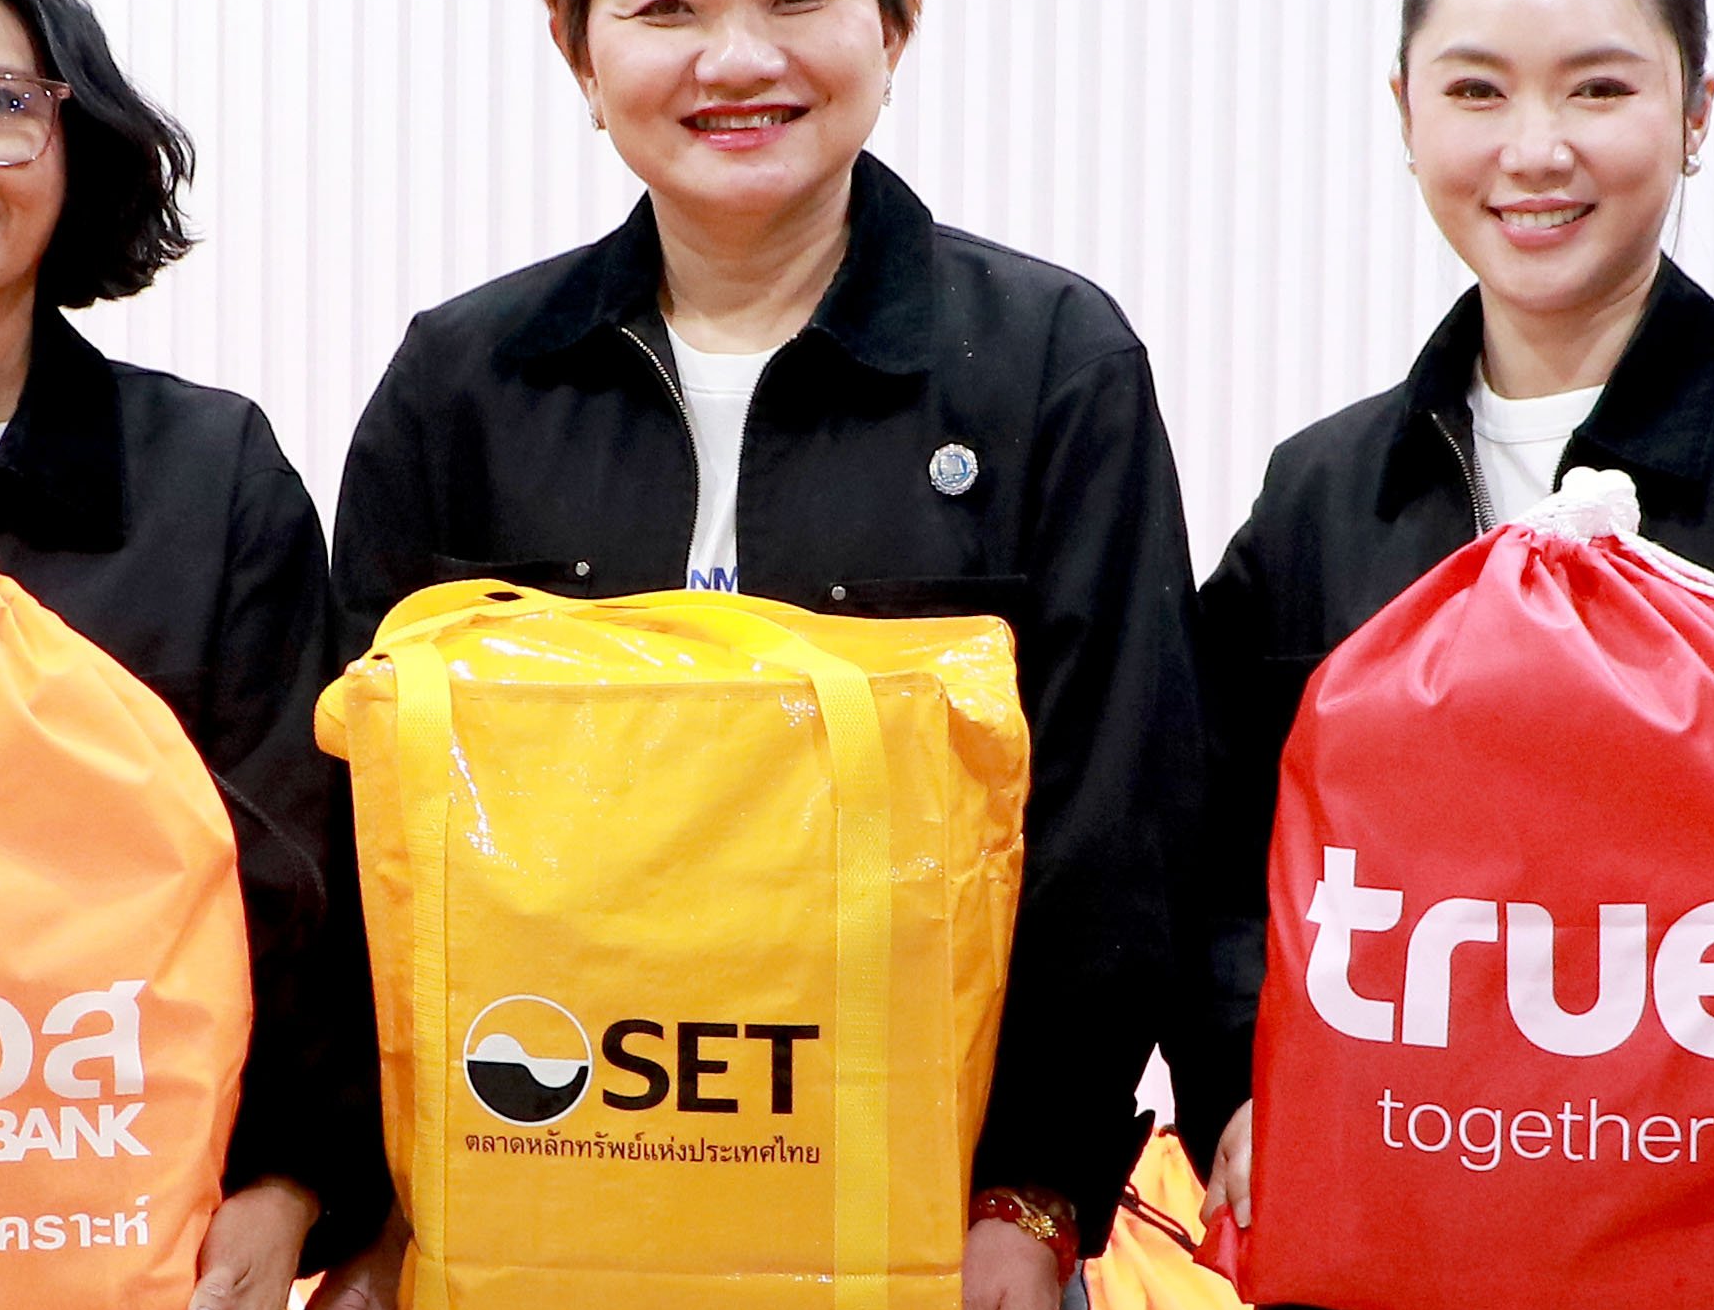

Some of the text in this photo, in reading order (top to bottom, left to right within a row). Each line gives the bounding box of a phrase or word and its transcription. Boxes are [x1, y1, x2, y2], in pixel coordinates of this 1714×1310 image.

[601, 1019, 820, 1115] SET
[465, 1131, 820, 1165] ตลาดหลักทรัพย์แห่งประเทศไทย
[1377, 1089, 1714, 1171] together
